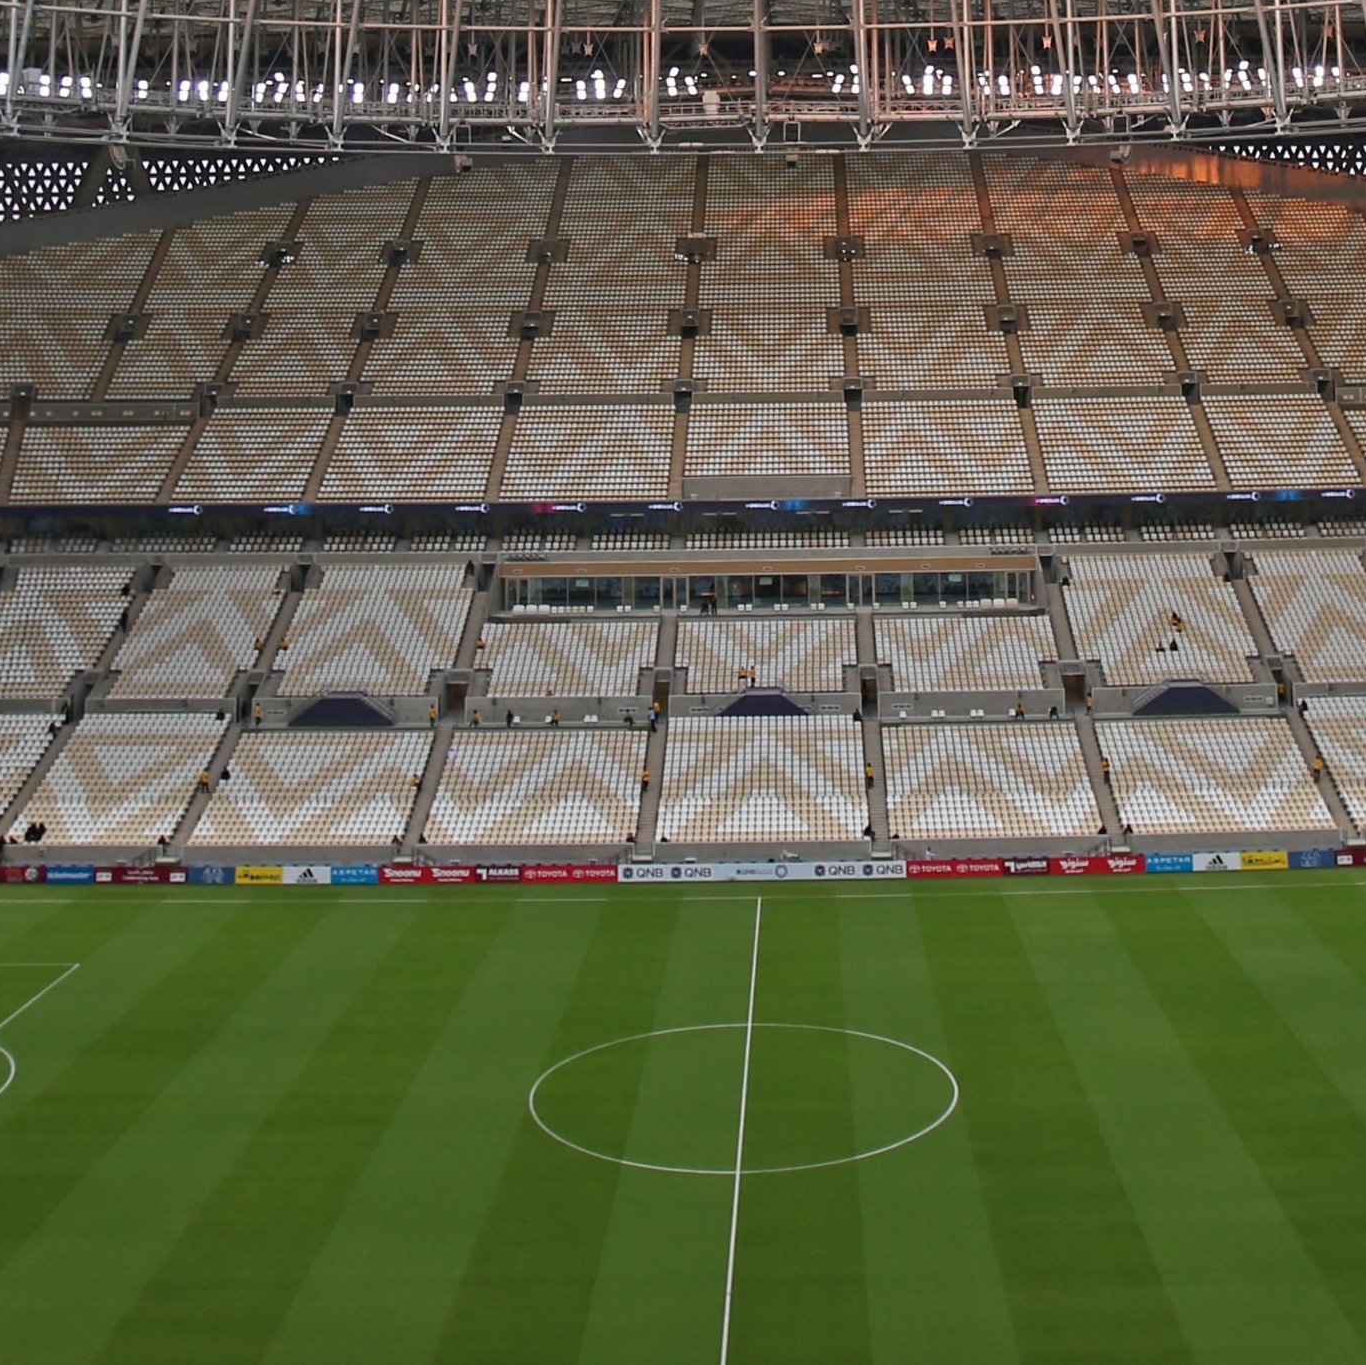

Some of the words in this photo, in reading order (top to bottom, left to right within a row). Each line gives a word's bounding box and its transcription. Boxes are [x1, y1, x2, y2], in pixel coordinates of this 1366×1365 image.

[1147, 856, 1191, 864] ASPETAR
[383, 868, 422, 877] Snoonu
[431, 868, 470, 877] Snoonu
[488, 868, 519, 876] ALKASS
[684, 867, 712, 878] QNB
[828, 865, 855, 876] QNB
[876, 864, 903, 875] QNB
[922, 864, 951, 873] TOYOTA
[969, 864, 999, 872] TOYOTA
[537, 870, 567, 878] TOYOTA
[585, 869, 615, 877] TOYOTA
[636, 868, 663, 878] QNB
